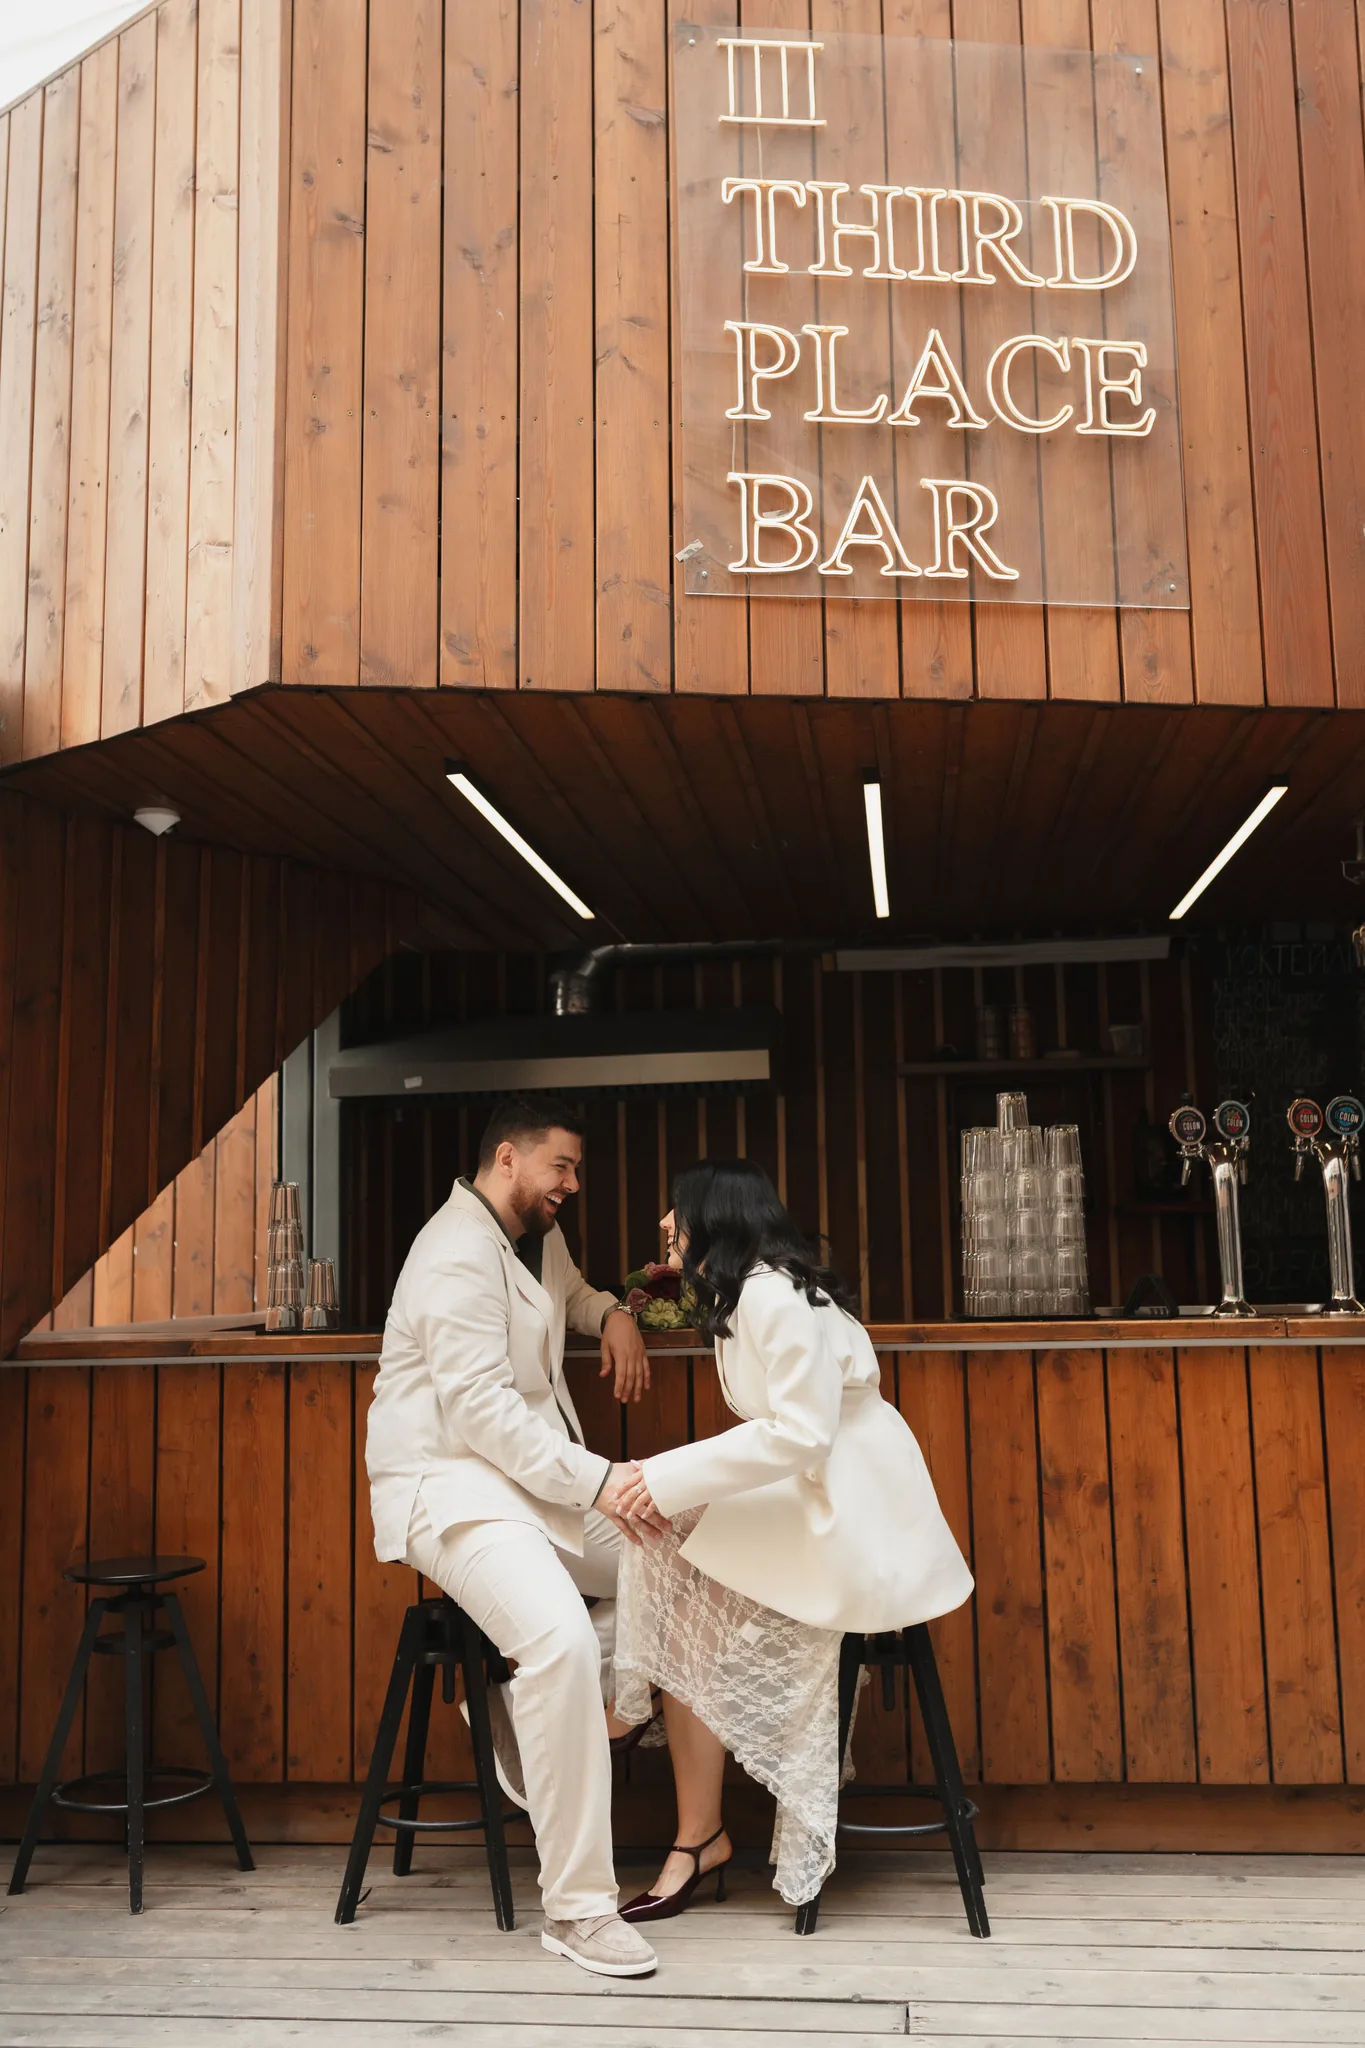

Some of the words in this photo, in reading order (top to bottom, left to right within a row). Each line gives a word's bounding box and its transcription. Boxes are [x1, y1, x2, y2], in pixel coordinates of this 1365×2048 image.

[721, 177, 1138, 290] THIRD
[723, 319, 1156, 438] PLACE
[726, 472, 1020, 580] BAR
[1226, 1117, 1244, 1128] COLON
[1300, 1113, 1319, 1124] COLON
[1339, 1111, 1360, 1124] COLON
[1182, 1120, 1201, 1131] COLON
